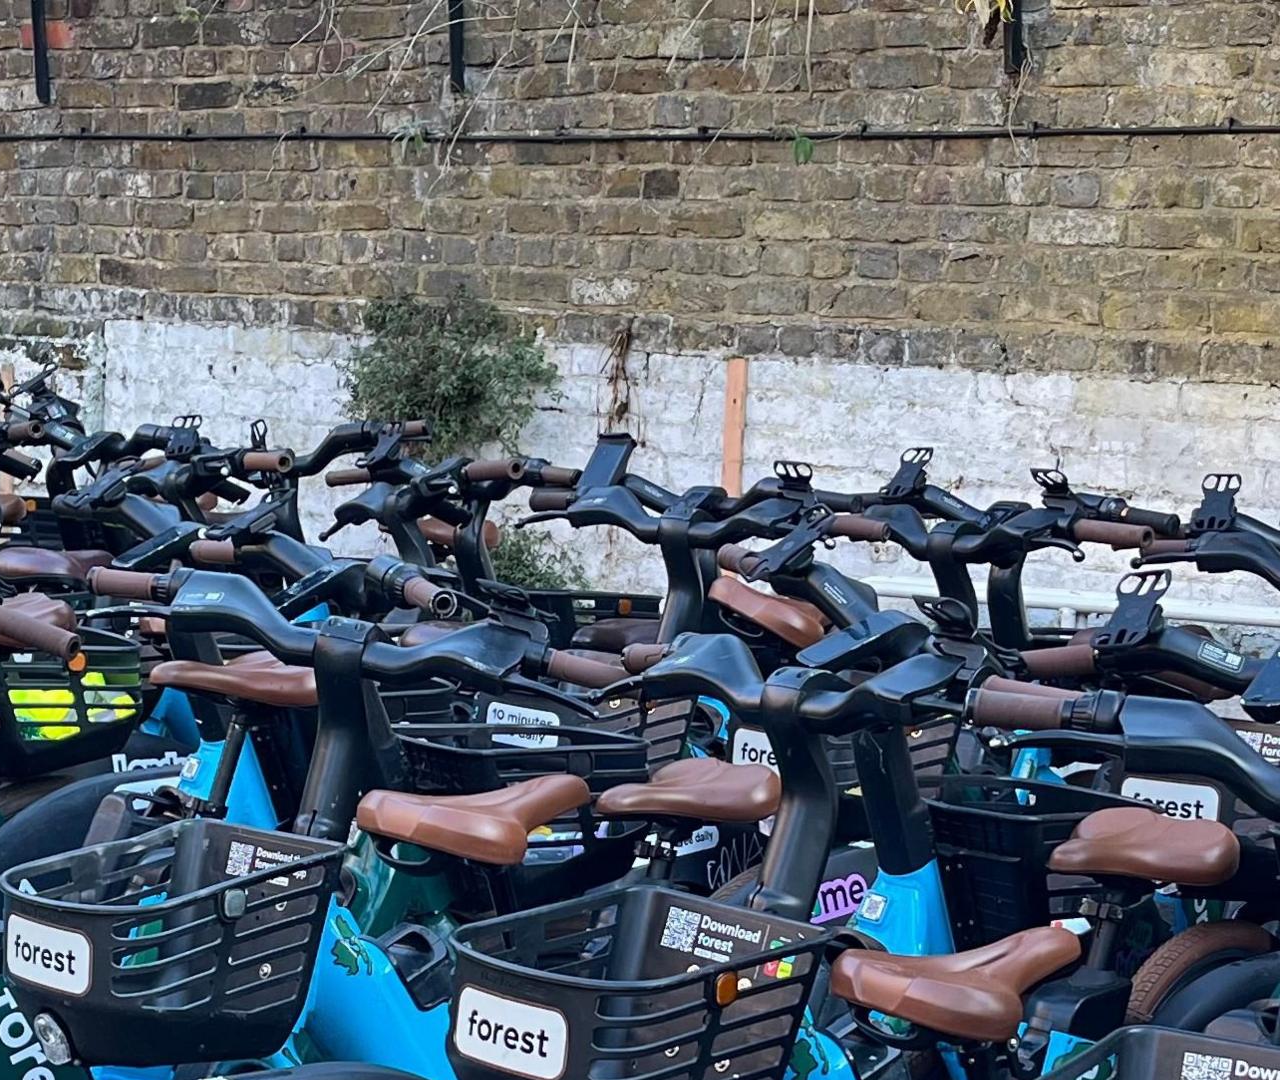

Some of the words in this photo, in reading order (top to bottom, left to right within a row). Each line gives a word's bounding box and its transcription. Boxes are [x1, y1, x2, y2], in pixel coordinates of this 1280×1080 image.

[491, 707, 505, 719] 10
[256, 846, 294, 863] Download
[697, 932, 734, 954] forest
[700, 915, 762, 945] Download
[14, 934, 76, 976] forest
[467, 1008, 550, 1059] forest
